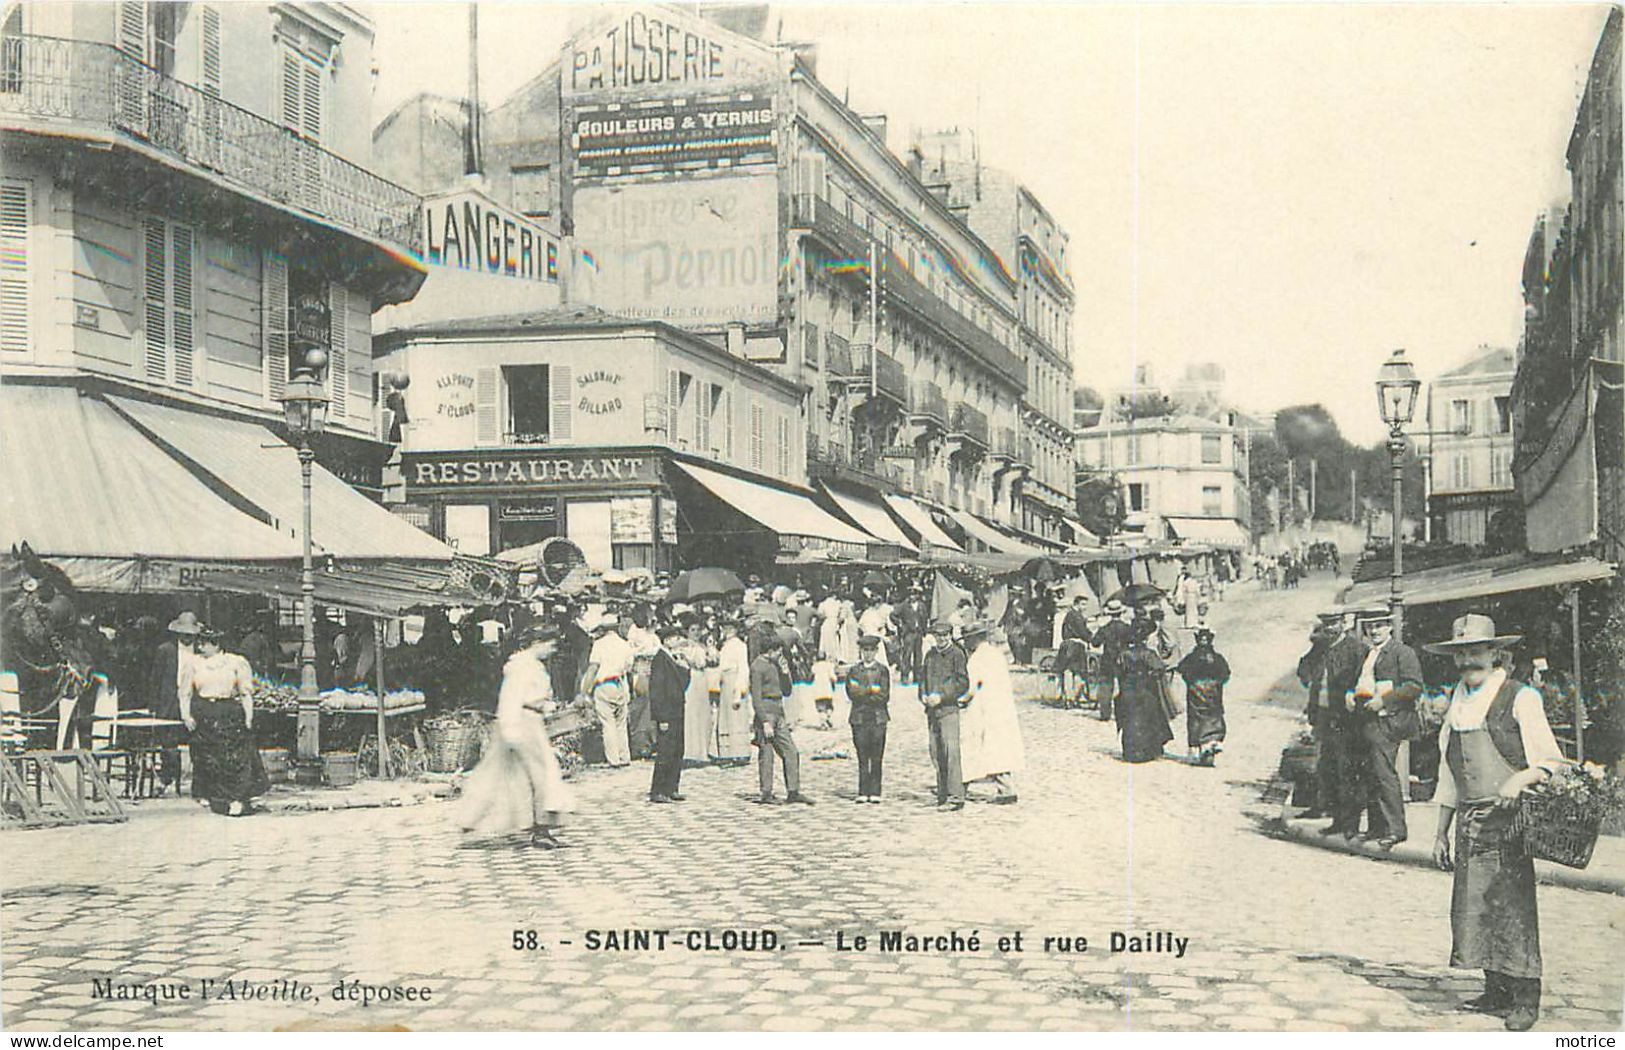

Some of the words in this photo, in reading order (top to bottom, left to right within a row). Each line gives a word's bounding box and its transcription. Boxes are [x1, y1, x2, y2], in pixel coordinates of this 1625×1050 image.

[572, 11, 724, 89] PATISSERIE
[577, 116, 675, 136] COULEURS
[681, 116, 696, 129] &
[698, 108, 772, 129] VERNIS
[576, 371, 605, 388] SALON
[578, 396, 622, 415] BILLARD
[415, 457, 643, 485] RESTAURANT
